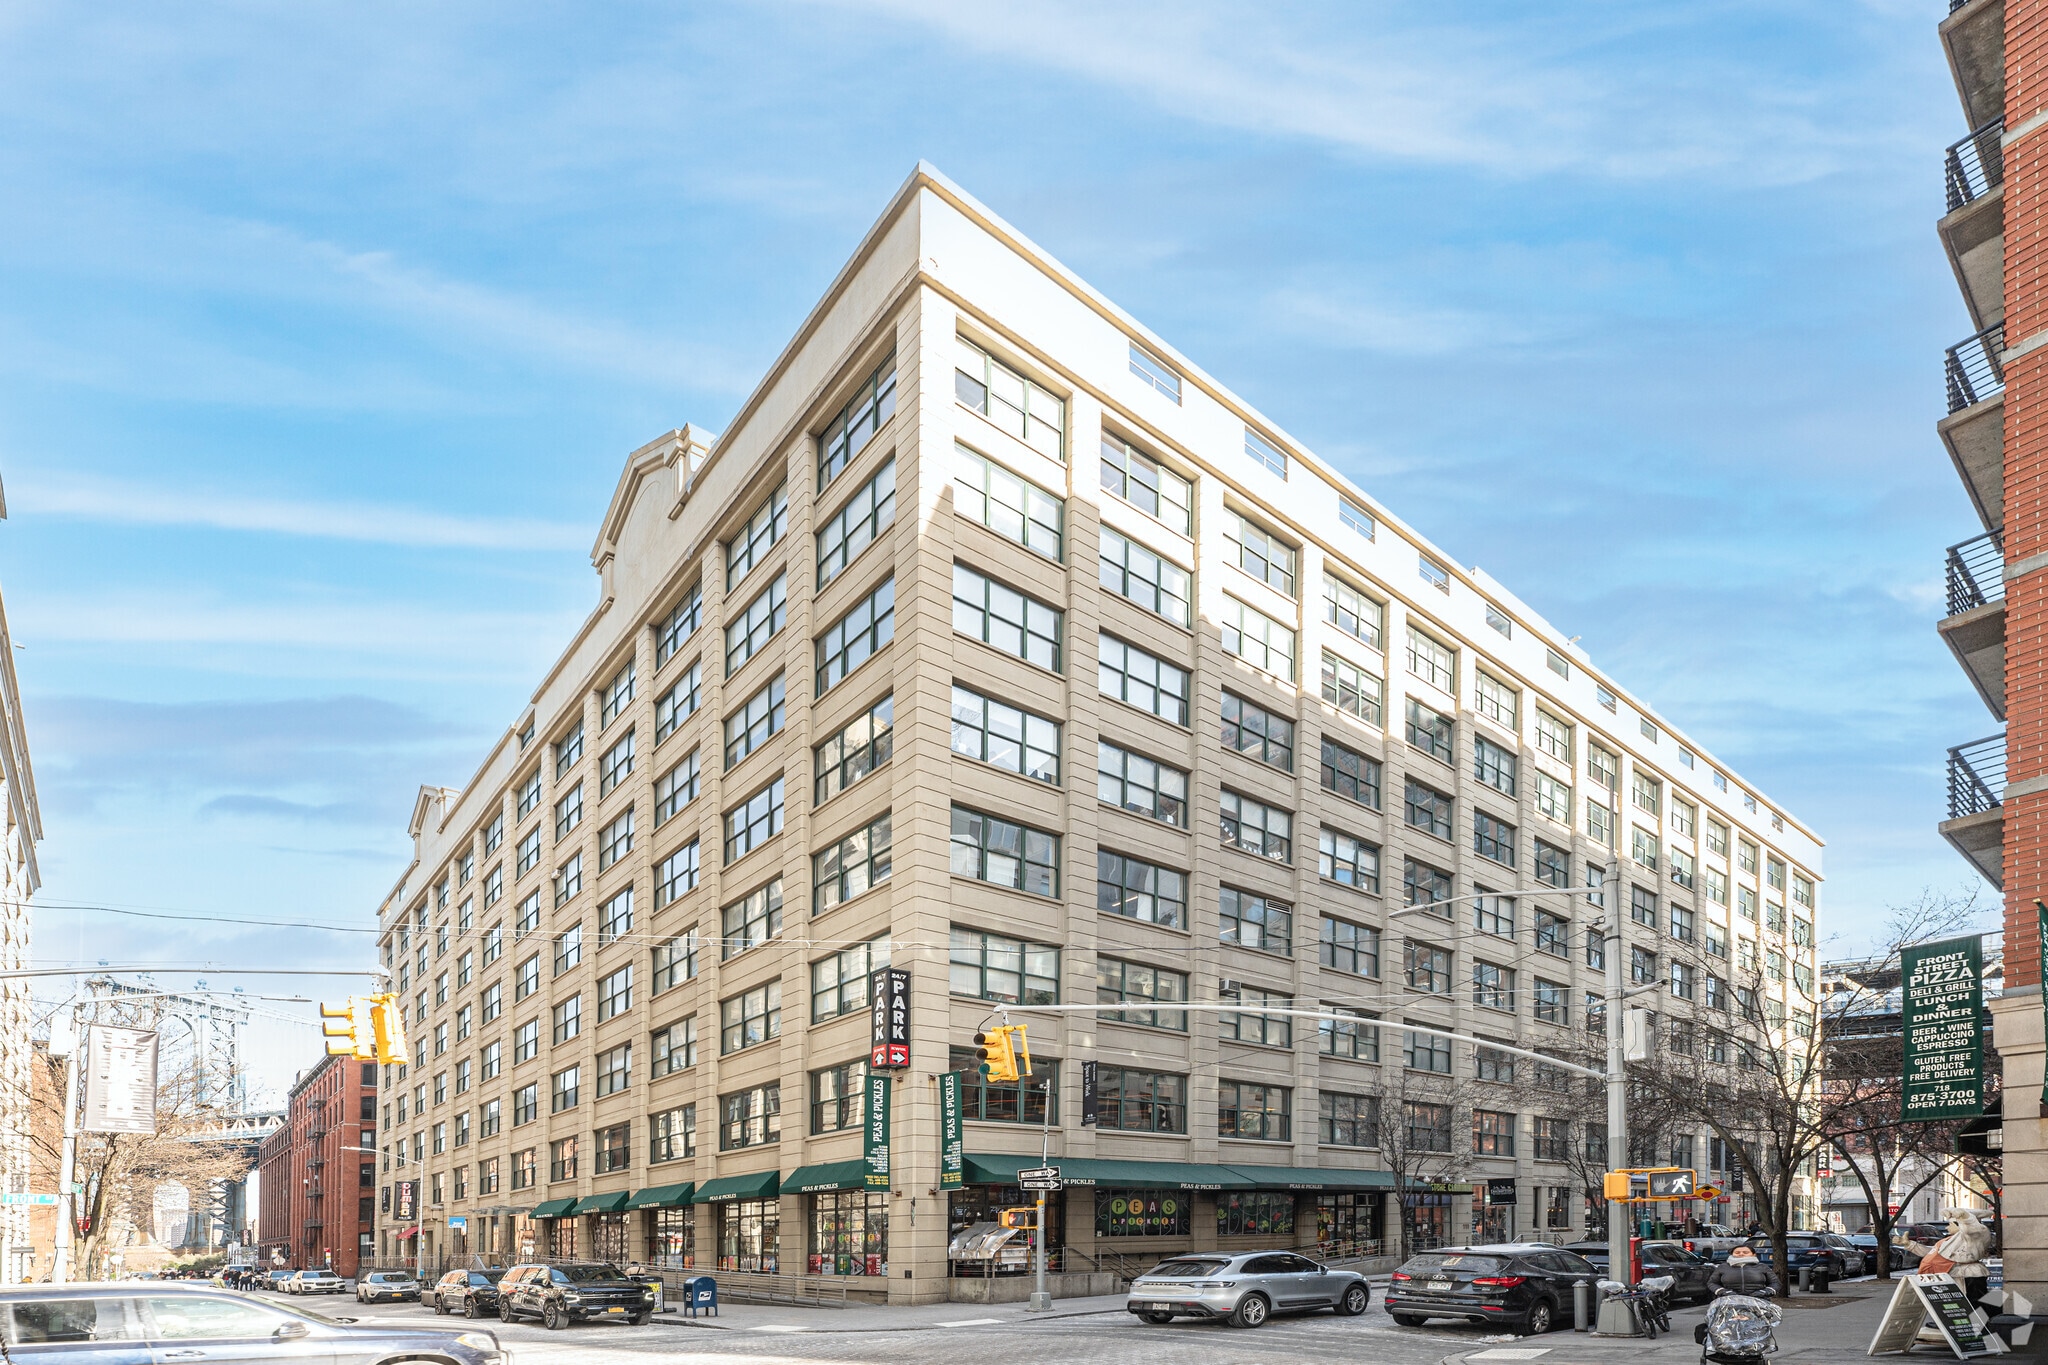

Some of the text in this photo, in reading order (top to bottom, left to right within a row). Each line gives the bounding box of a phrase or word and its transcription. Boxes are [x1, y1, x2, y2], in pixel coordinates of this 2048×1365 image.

[1917, 952, 1965, 966] FRONT
[1914, 959, 1969, 974] STREET
[1910, 968, 1974, 987] PIZZA
[1910, 988, 1931, 998] DELI
[1945, 982, 1974, 992] GRILL
[1916, 992, 1969, 1006] LUNCH
[875, 982, 885, 1040] PARK
[892, 980, 906, 1040] PARK
[1913, 1008, 1972, 1022] DINNER
[1936, 1004, 1948, 1012] &
[1912, 1022, 1974, 1036] BEER WINE
[1912, 1030, 1974, 1044] CAPPUCCINO
[1917, 1039, 1968, 1051] ESPRESSO
[1914, 1053, 1972, 1066] GLUTEN FREE
[1920, 1062, 1964, 1072] PRODUCTS
[1910, 1068, 1975, 1081] FREE DELIVERY
[945, 1075, 955, 1108] PICKLES
[1910, 1090, 1975, 1102] 875-3700
[873, 1080, 884, 1142] PEAS & PICKLES
[946, 1108, 955, 1116] &
[1908, 1101, 1936, 1109] OPEN
[946, 1118, 956, 1139] PEAS
[6, 1194, 40, 1204] FRONT
[401, 1183, 412, 1216] DUMBO
[1114, 1200, 1174, 1213] PEAS
